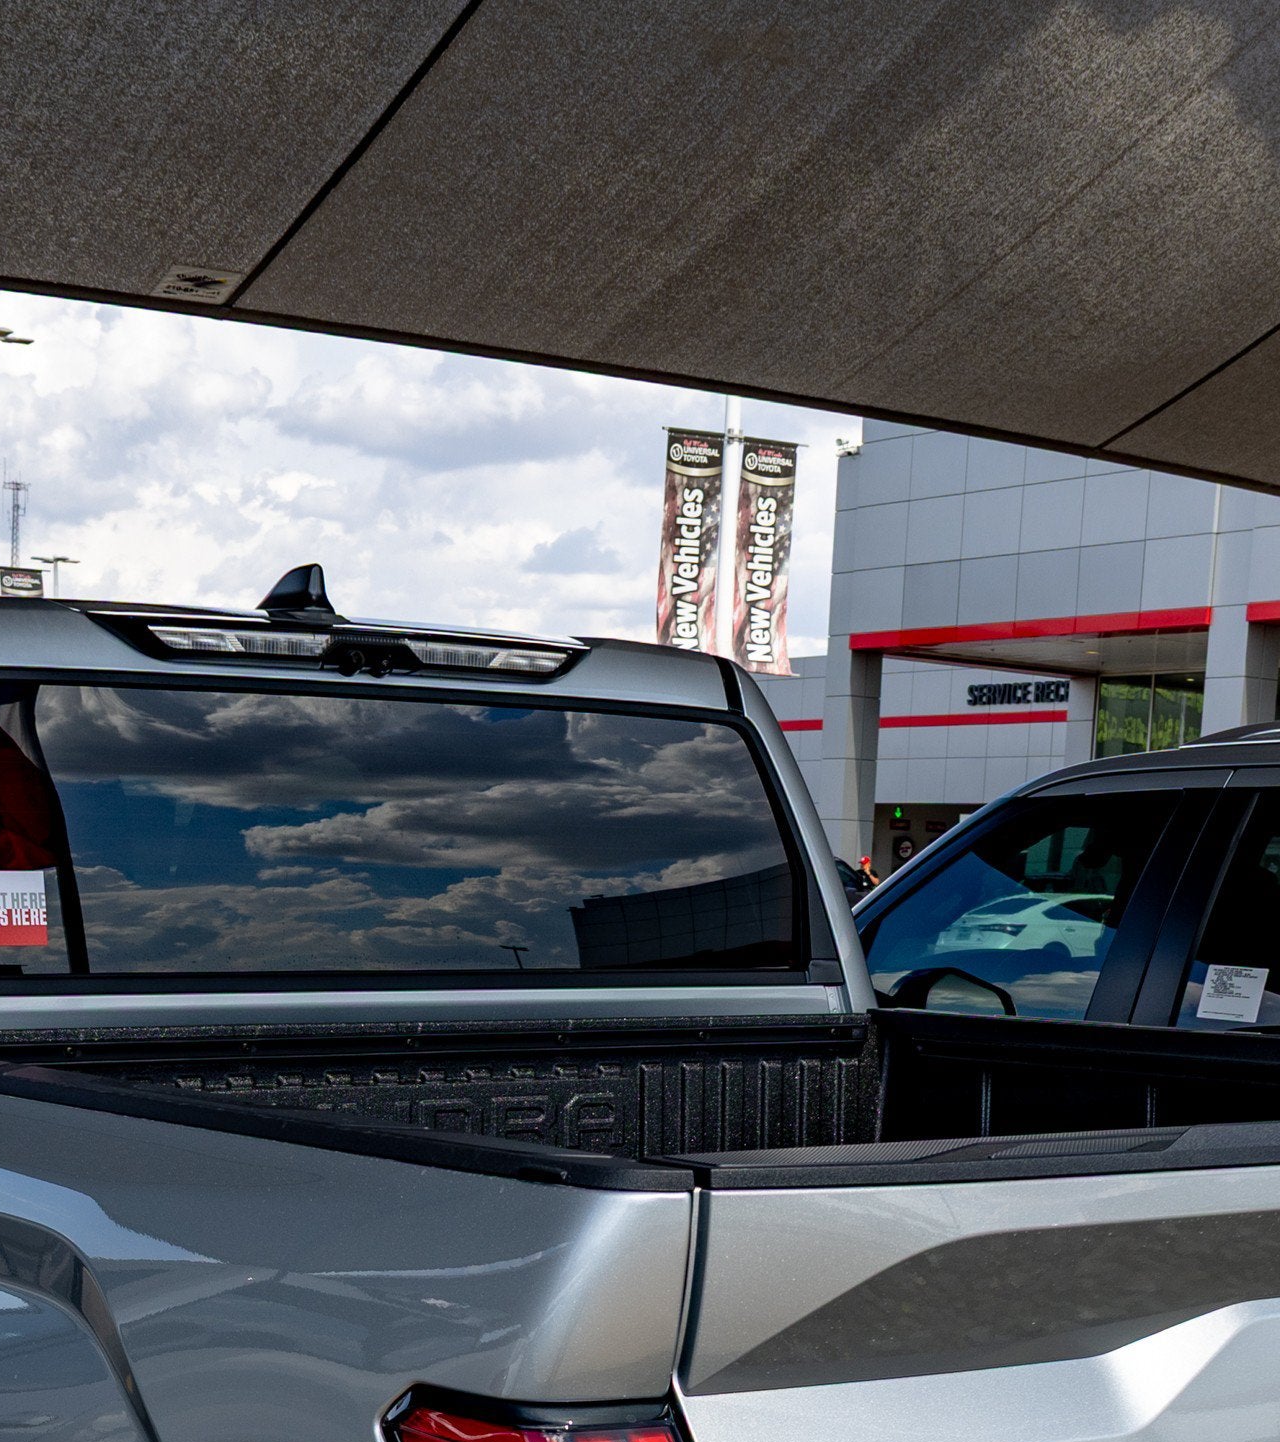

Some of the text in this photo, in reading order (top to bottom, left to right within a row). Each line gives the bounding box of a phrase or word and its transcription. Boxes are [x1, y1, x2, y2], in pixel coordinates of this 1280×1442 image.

[683, 446, 720, 458] UNIVERSAL
[683, 454, 708, 463] TOYOTA
[757, 456, 793, 467] UNIVERSAL
[757, 463, 781, 474] TOYOTA
[672, 487, 704, 595] Vehicles
[746, 496, 777, 662] New Vehicles
[967, 682, 1032, 706] SERVICE
[11, 892, 46, 909] HERE
[12, 908, 48, 926] HERE
